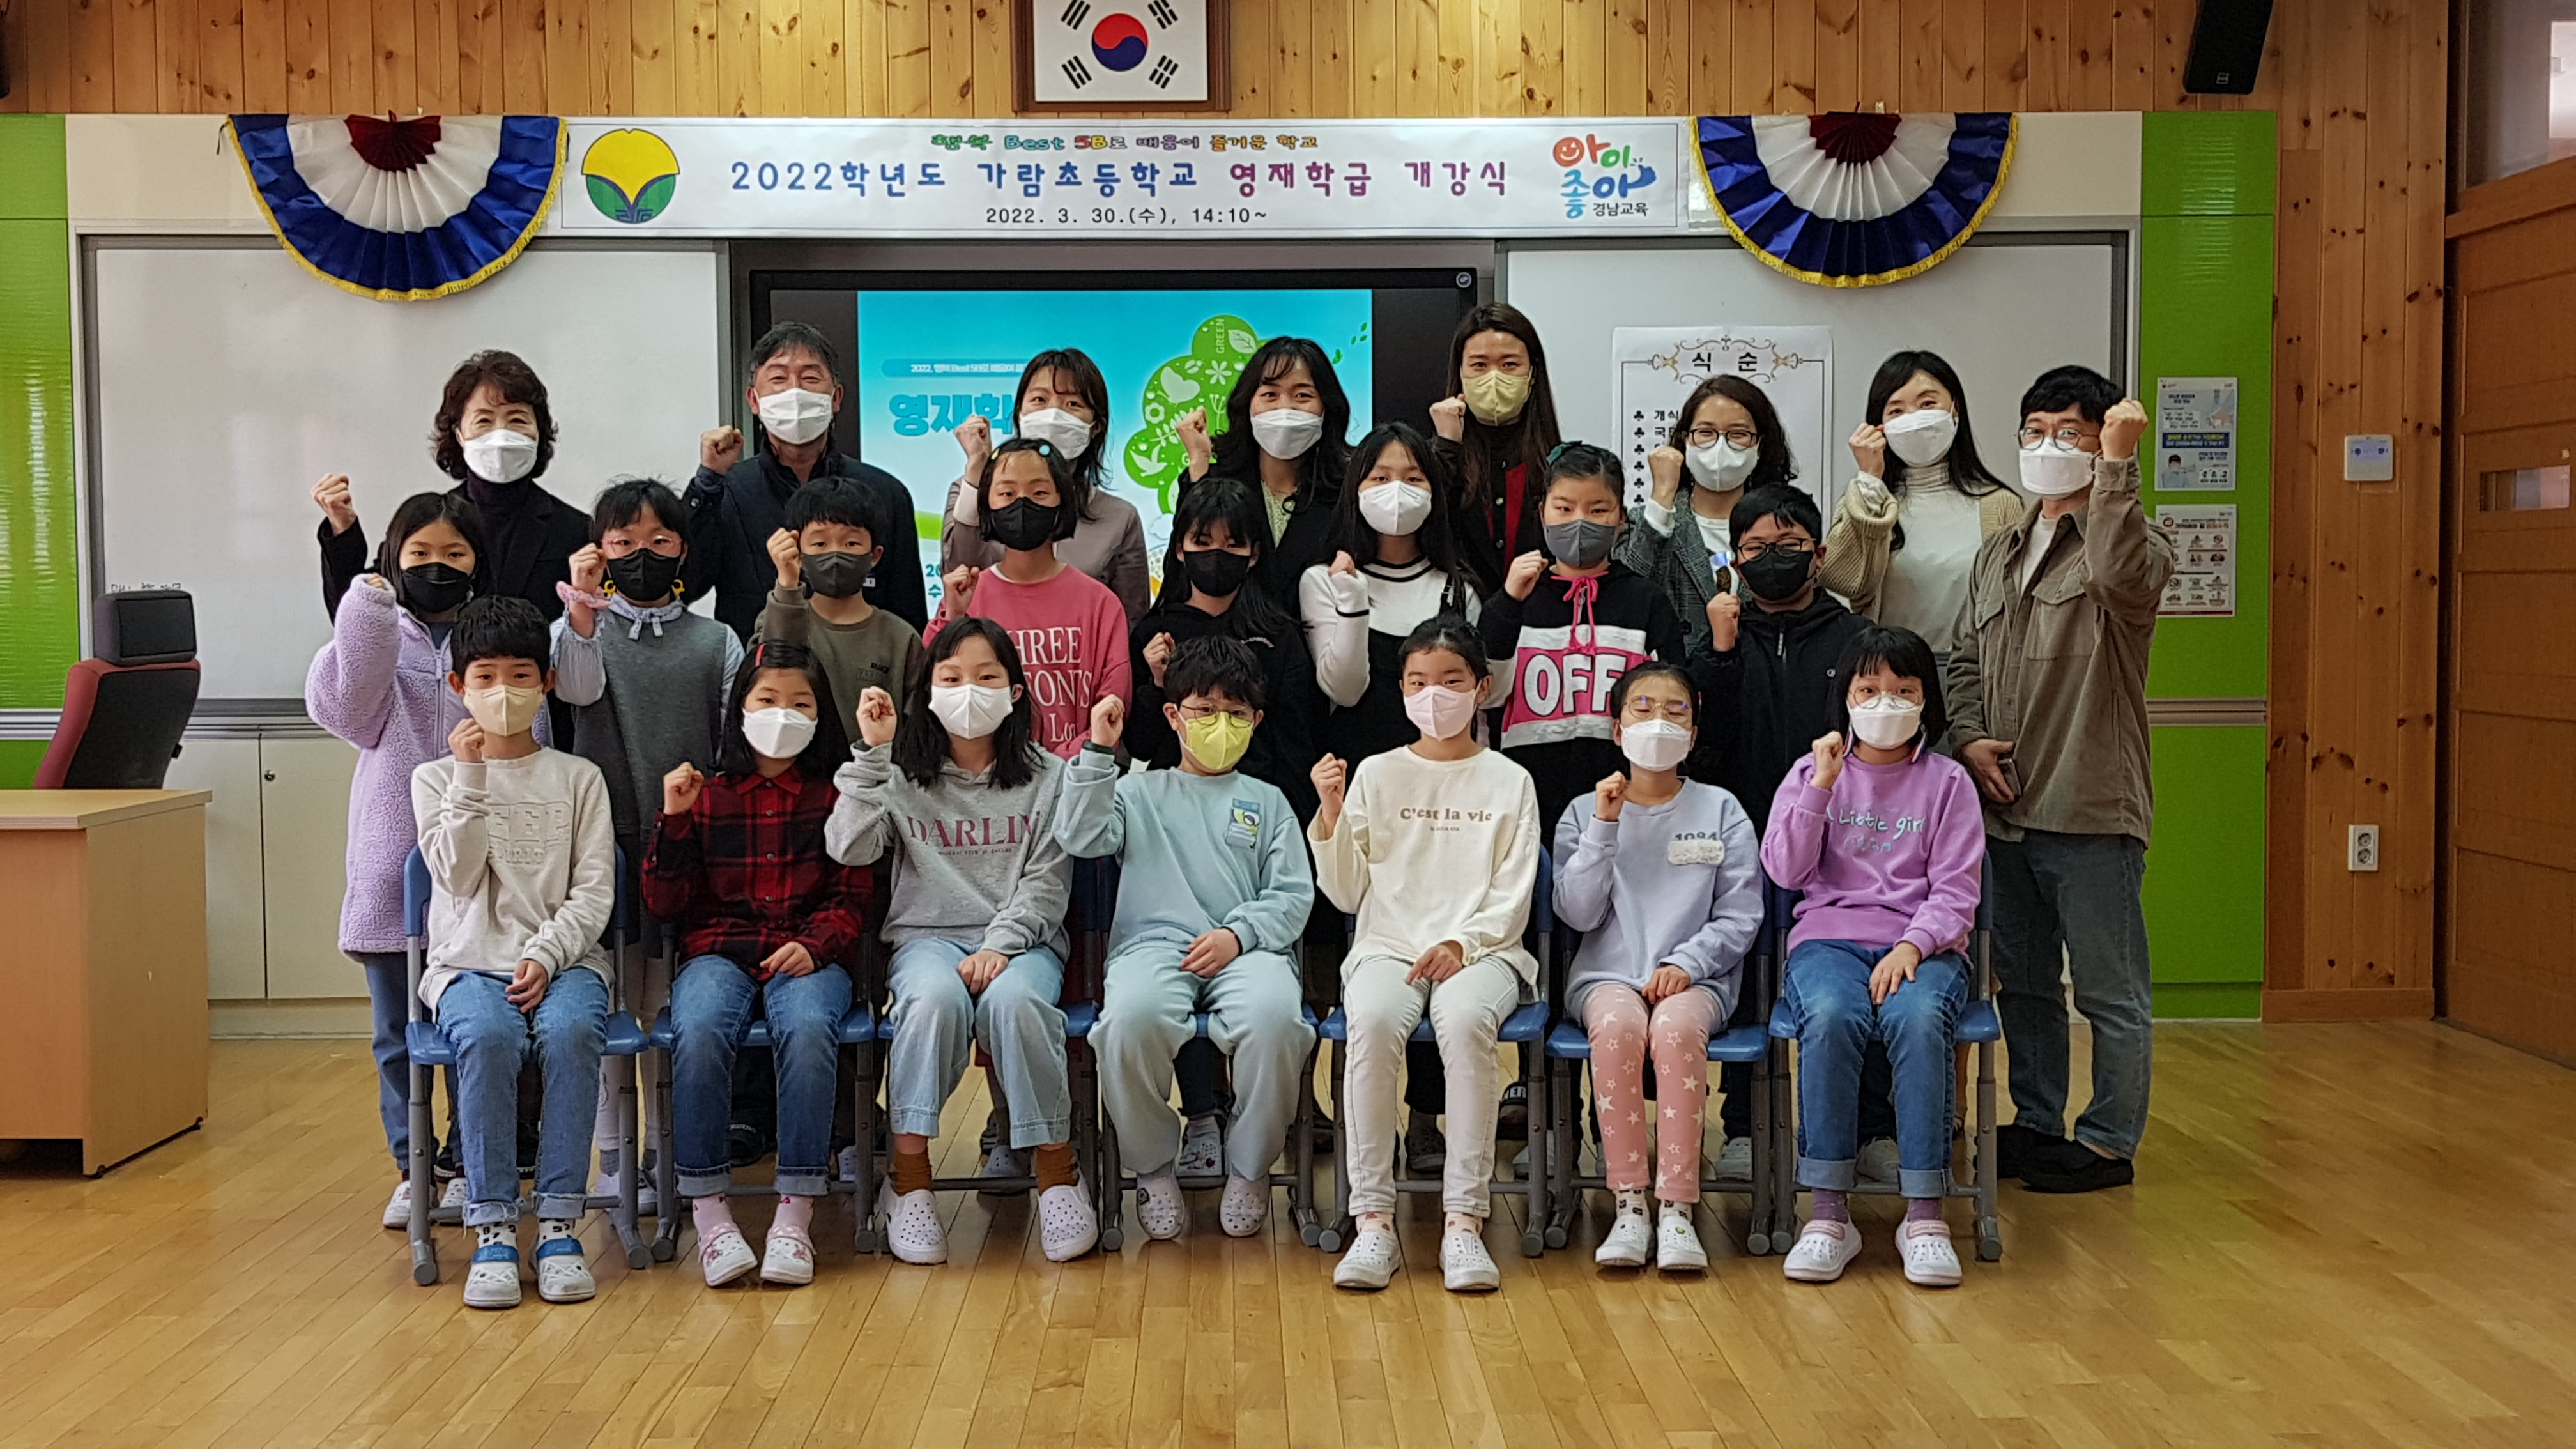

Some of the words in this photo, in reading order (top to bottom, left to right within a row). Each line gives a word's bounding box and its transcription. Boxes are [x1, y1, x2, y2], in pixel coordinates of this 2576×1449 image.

[931, 134, 993, 151] 행복
[1004, 135, 1065, 150] Best
[1210, 134, 1267, 151] 즐거운
[1276, 134, 1318, 150] 학교
[1553, 134, 1631, 168] 아이
[731, 161, 946, 197] 2022학년도
[977, 161, 1197, 197] 가람초등학교
[1230, 161, 1372, 197] 영재학급
[1404, 161, 1505, 197] 개강식
[1560, 164, 1657, 218] 좋아
[986, 208, 1044, 224] 2022.
[1058, 208, 1078, 223] 3.
[1593, 202, 1649, 217] 경남교육
[1216, 319, 1225, 354] GREEN
[1692, 351, 1712, 372] 식
[1738, 351, 1758, 372] 순
[1654, 410, 1679, 422] 개식
[1008, 627, 1082, 666] HREE
[1524, 653, 1627, 717] OFF
[1445, 808, 1461, 820] la
[1468, 810, 1492, 822] vie
[1839, 808, 1888, 831] Little
[1893, 816, 1926, 840] girl
